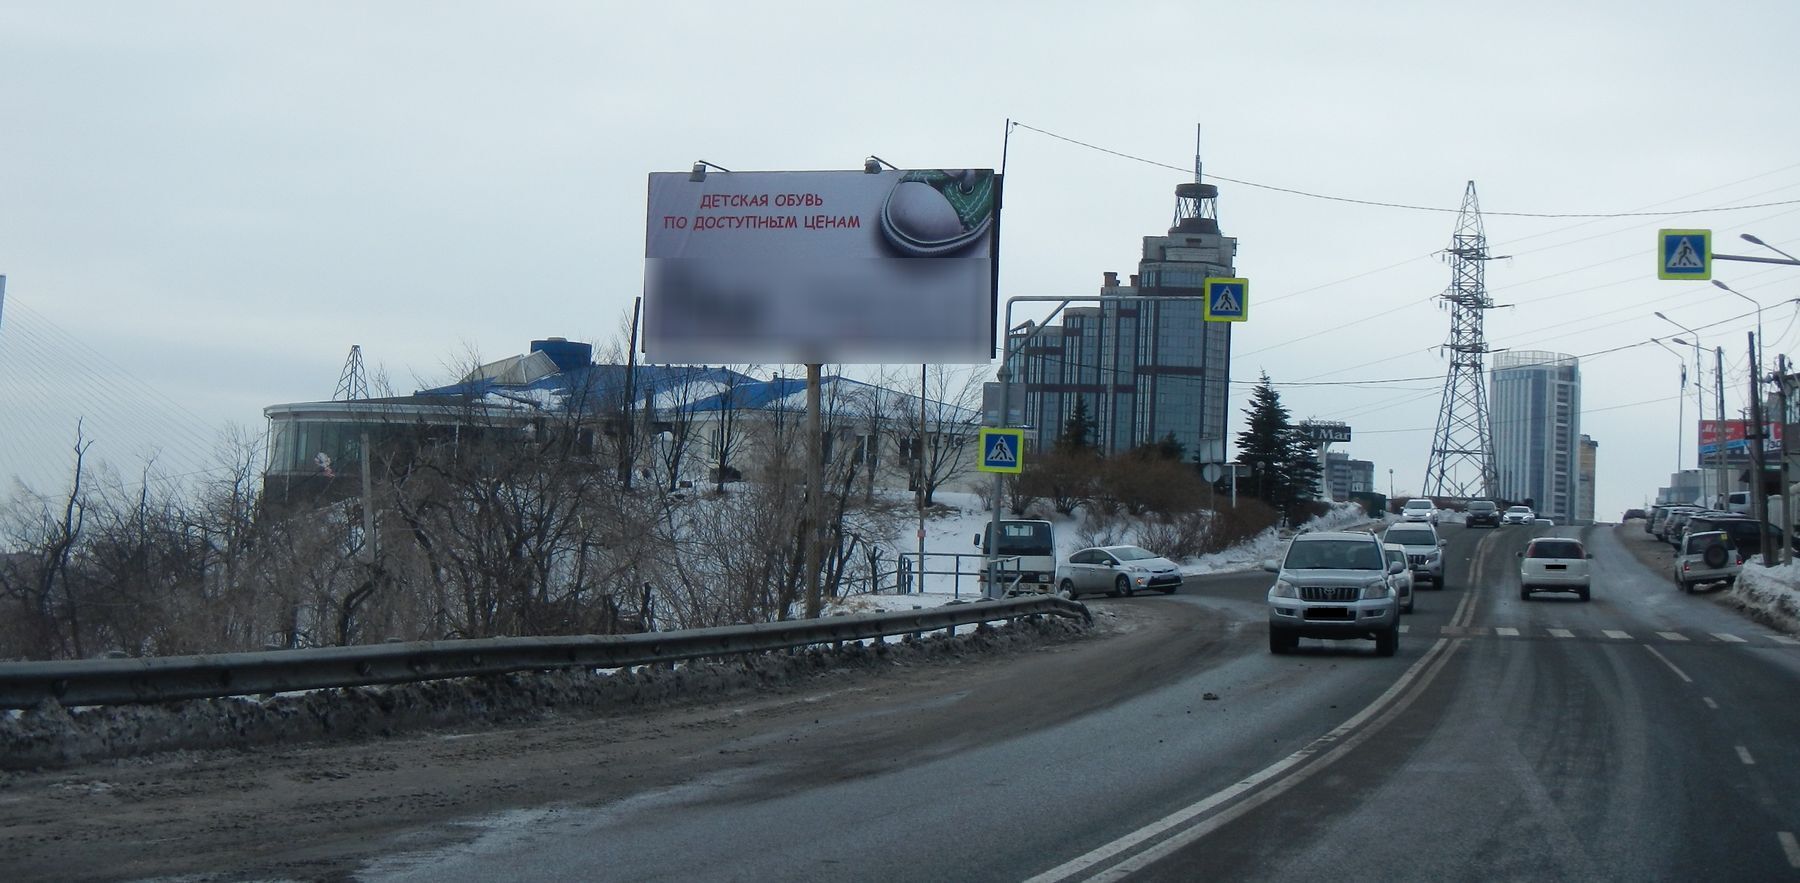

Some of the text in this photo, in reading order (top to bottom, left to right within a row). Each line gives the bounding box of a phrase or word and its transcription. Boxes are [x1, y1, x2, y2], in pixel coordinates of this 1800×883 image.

[700, 193, 824, 209] ДЕТСКАЯ ОБУВЬ
[663, 215, 861, 231] ПО ДОСТУПНЫМ ЦЕНАМ
